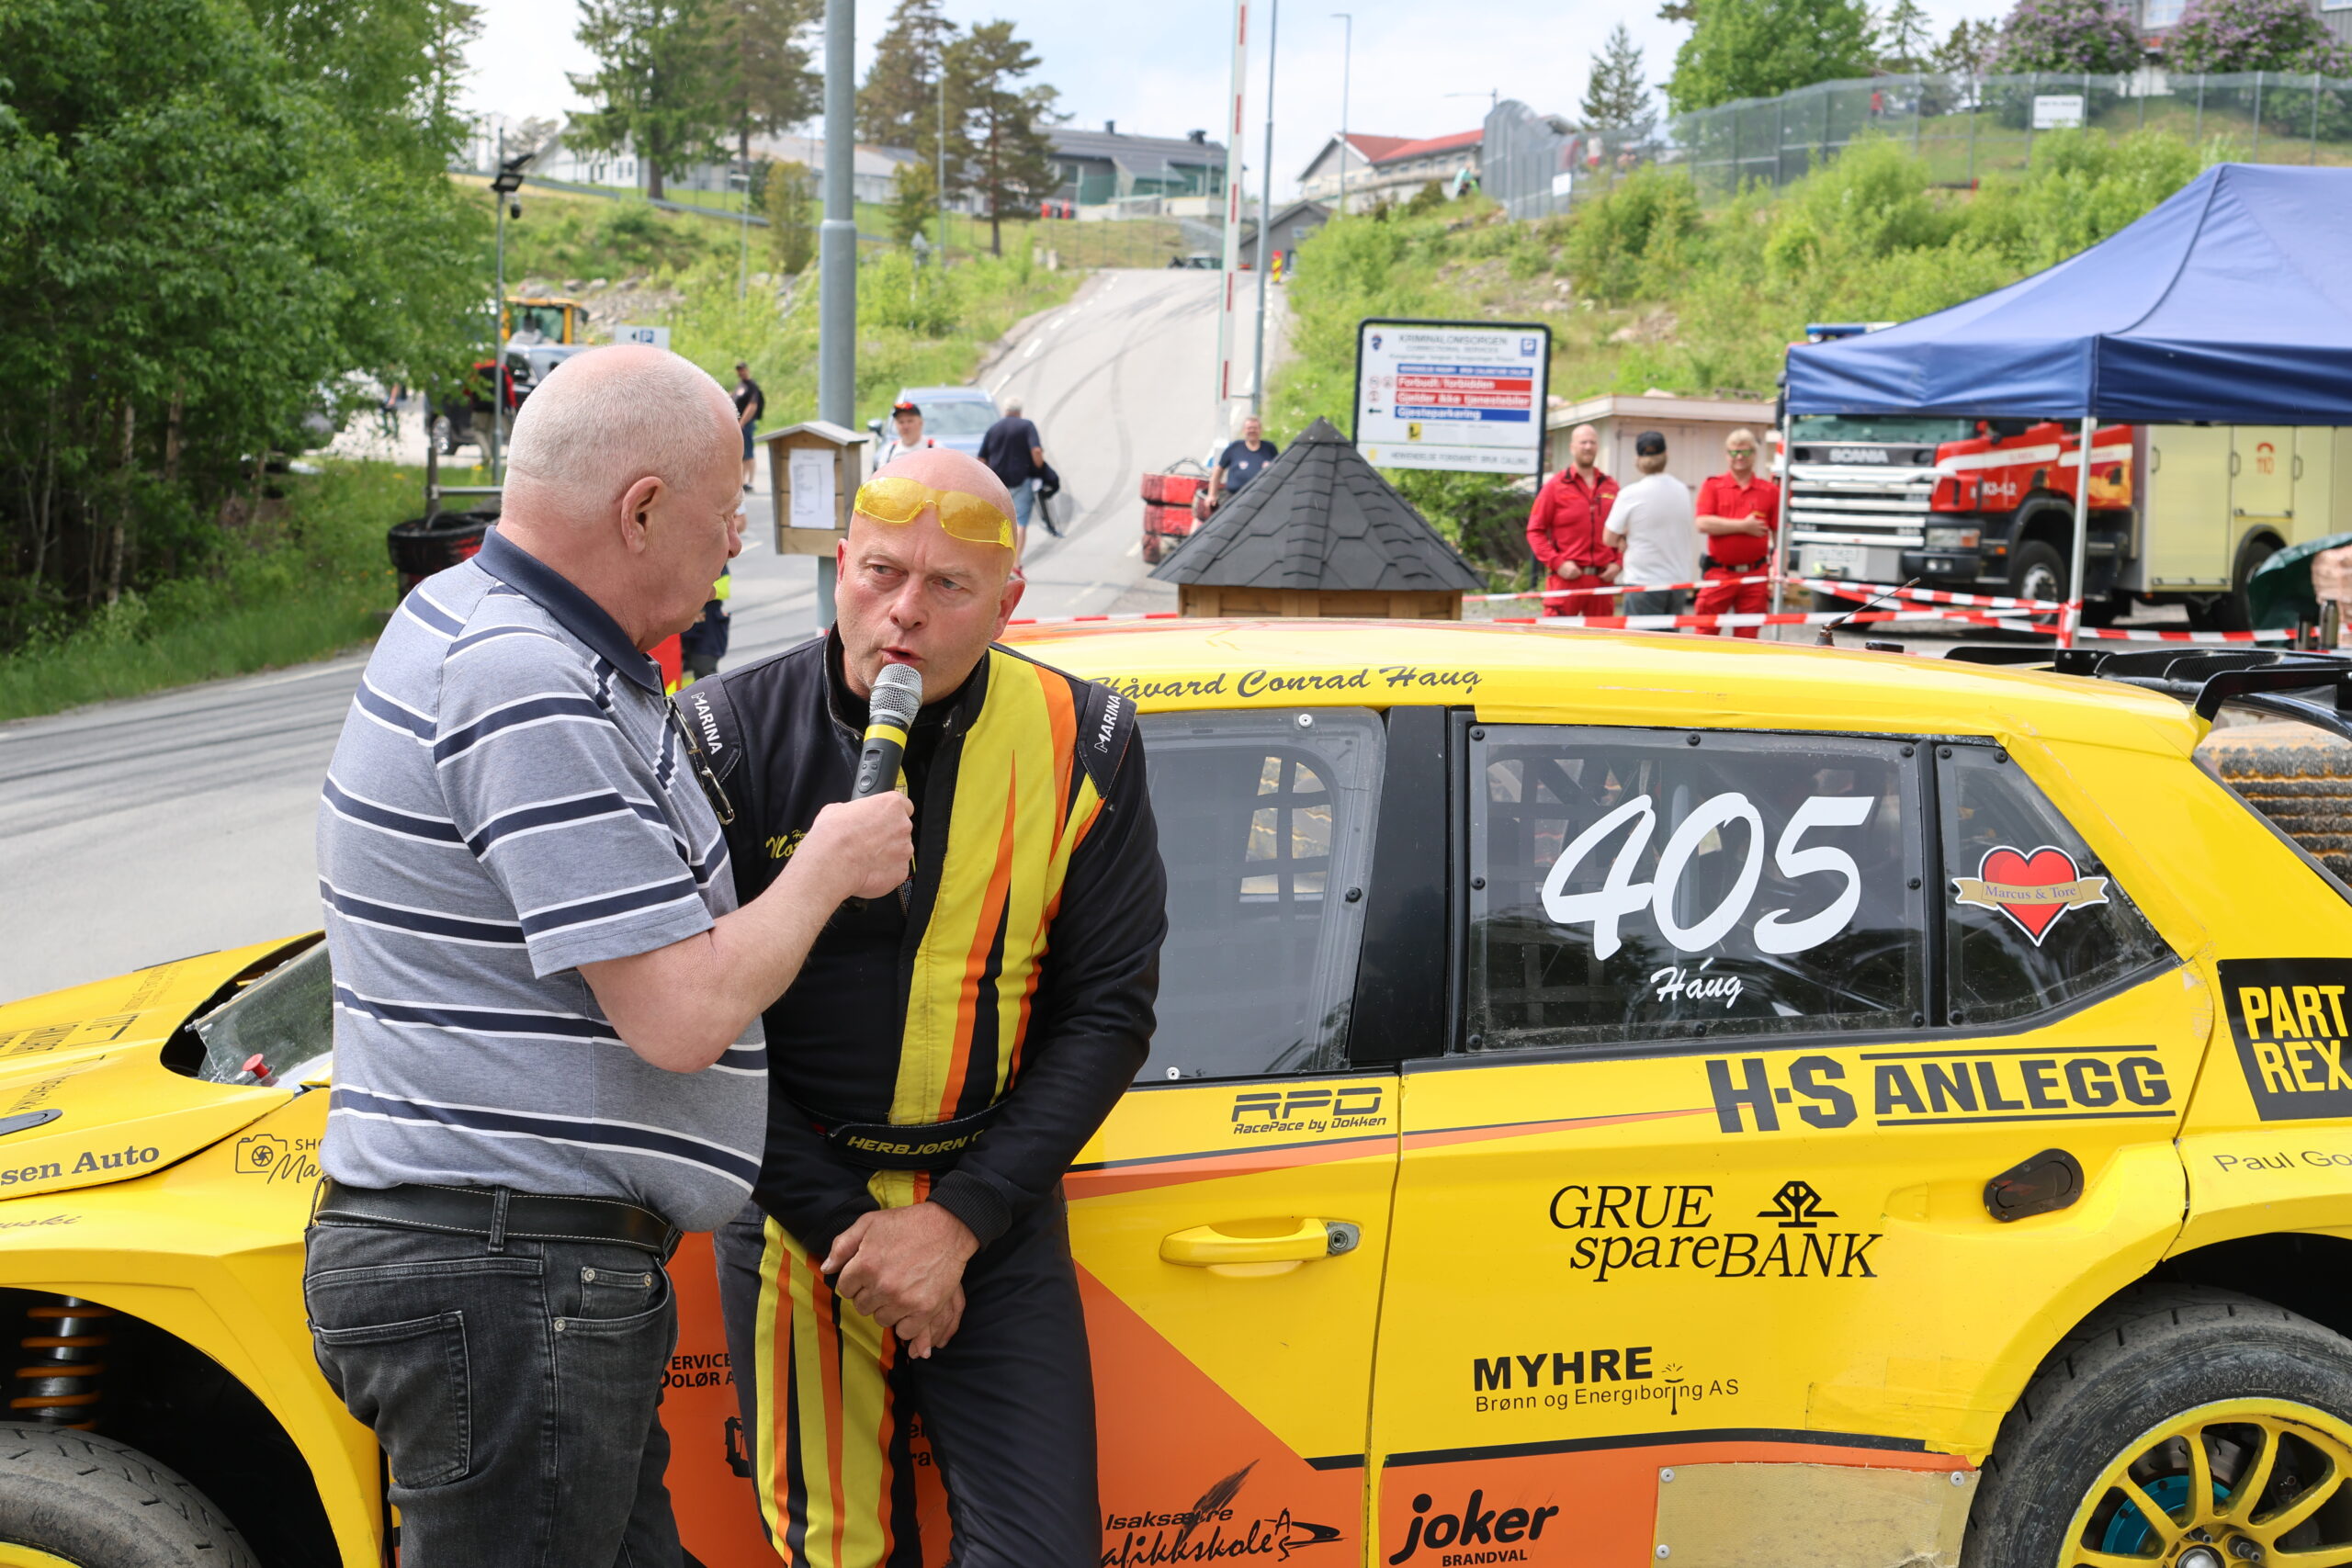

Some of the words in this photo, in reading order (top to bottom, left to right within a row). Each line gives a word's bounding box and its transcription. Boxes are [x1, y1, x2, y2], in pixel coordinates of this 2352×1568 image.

[1829, 447, 1889, 463] SCANIA
[1238, 669, 1371, 698] Conrad
[1379, 666, 1483, 694] Haug
[691, 691, 723, 755] MARINA
[1093, 694, 1122, 753] MARINA
[1541, 792, 1874, 961] 405
[1985, 885, 2031, 900] Marcus
[2036, 888, 2048, 900] &
[2050, 886, 2077, 899] Tore
[2238, 985, 2349, 1040] PART
[1874, 1056, 2171, 1114] ANLEGG
[1231, 1087, 1383, 1122] RPD
[1233, 1121, 1305, 1135] RacePace
[1308, 1119, 1327, 1133] by
[1332, 1116, 1387, 1129] Dokken
[295, 1139, 322, 1151] SH
[846, 1135, 968, 1156] HERBJØRN
[2213, 1152, 2295, 1172] Paul
[2301, 1150, 2352, 1168] Go
[0, 1161, 62, 1186] sen
[72, 1145, 160, 1174] Auto
[267, 1154, 322, 1184] Ma
[1550, 1185, 1714, 1230] GRUE
[1570, 1233, 1883, 1282] spareBANK
[672, 1353, 732, 1371] ERVICE
[1474, 1347, 1653, 1392] MYHRE
[1475, 1393, 1536, 1413] Brønn
[1544, 1393, 1568, 1410] og
[1576, 1382, 1703, 1408] Energiboring
[1709, 1379, 1739, 1396] AS
[1102, 1519, 1273, 1567] afikkskole
[1388, 1488, 1559, 1565] joker
[1442, 1549, 1528, 1567] BRANDVAL
